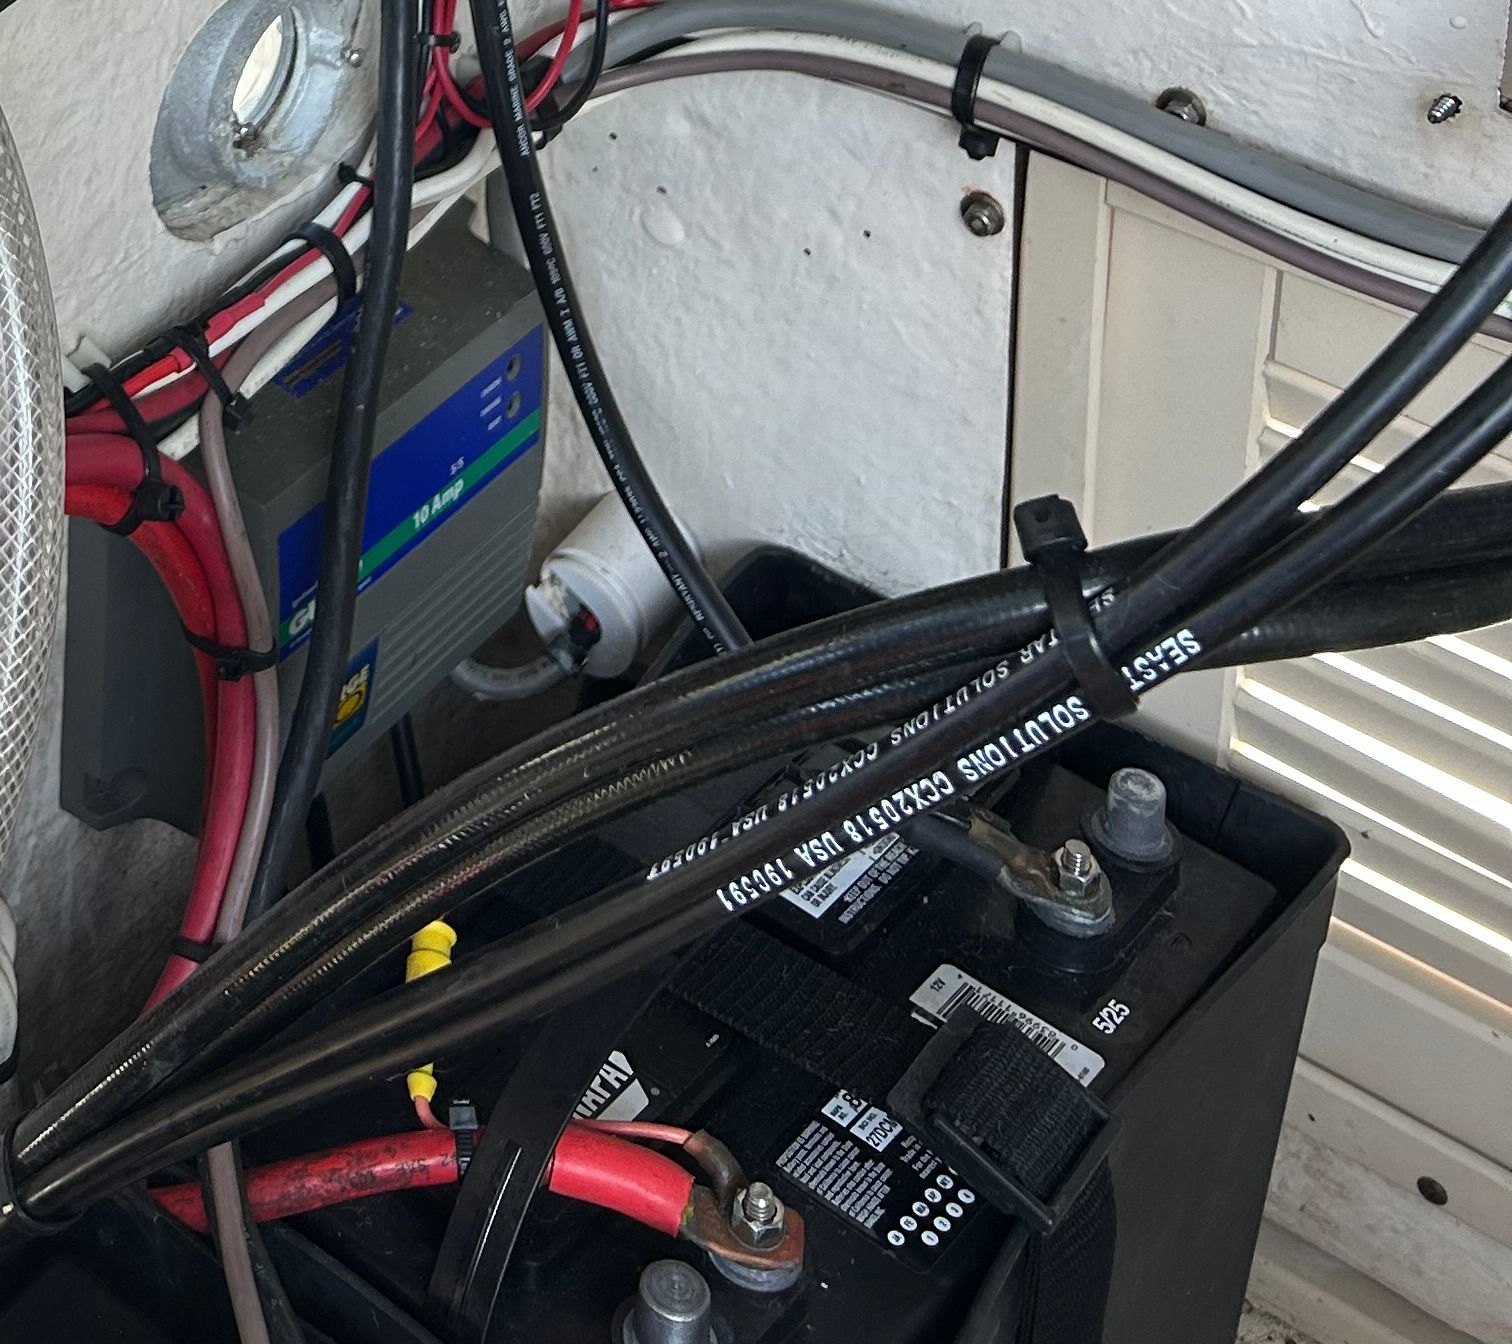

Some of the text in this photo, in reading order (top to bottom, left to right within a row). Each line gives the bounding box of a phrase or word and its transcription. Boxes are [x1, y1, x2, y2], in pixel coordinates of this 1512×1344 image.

[411, 478, 464, 529] 10 Amp
[1120, 628, 1201, 691] SEAST
[891, 666, 1010, 745] SOLUTIONS
[957, 695, 1091, 782] SOLUTIONS
[844, 769, 955, 844] CCX20518
[793, 828, 845, 868] USA
[1092, 999, 1132, 1036] 5/25
